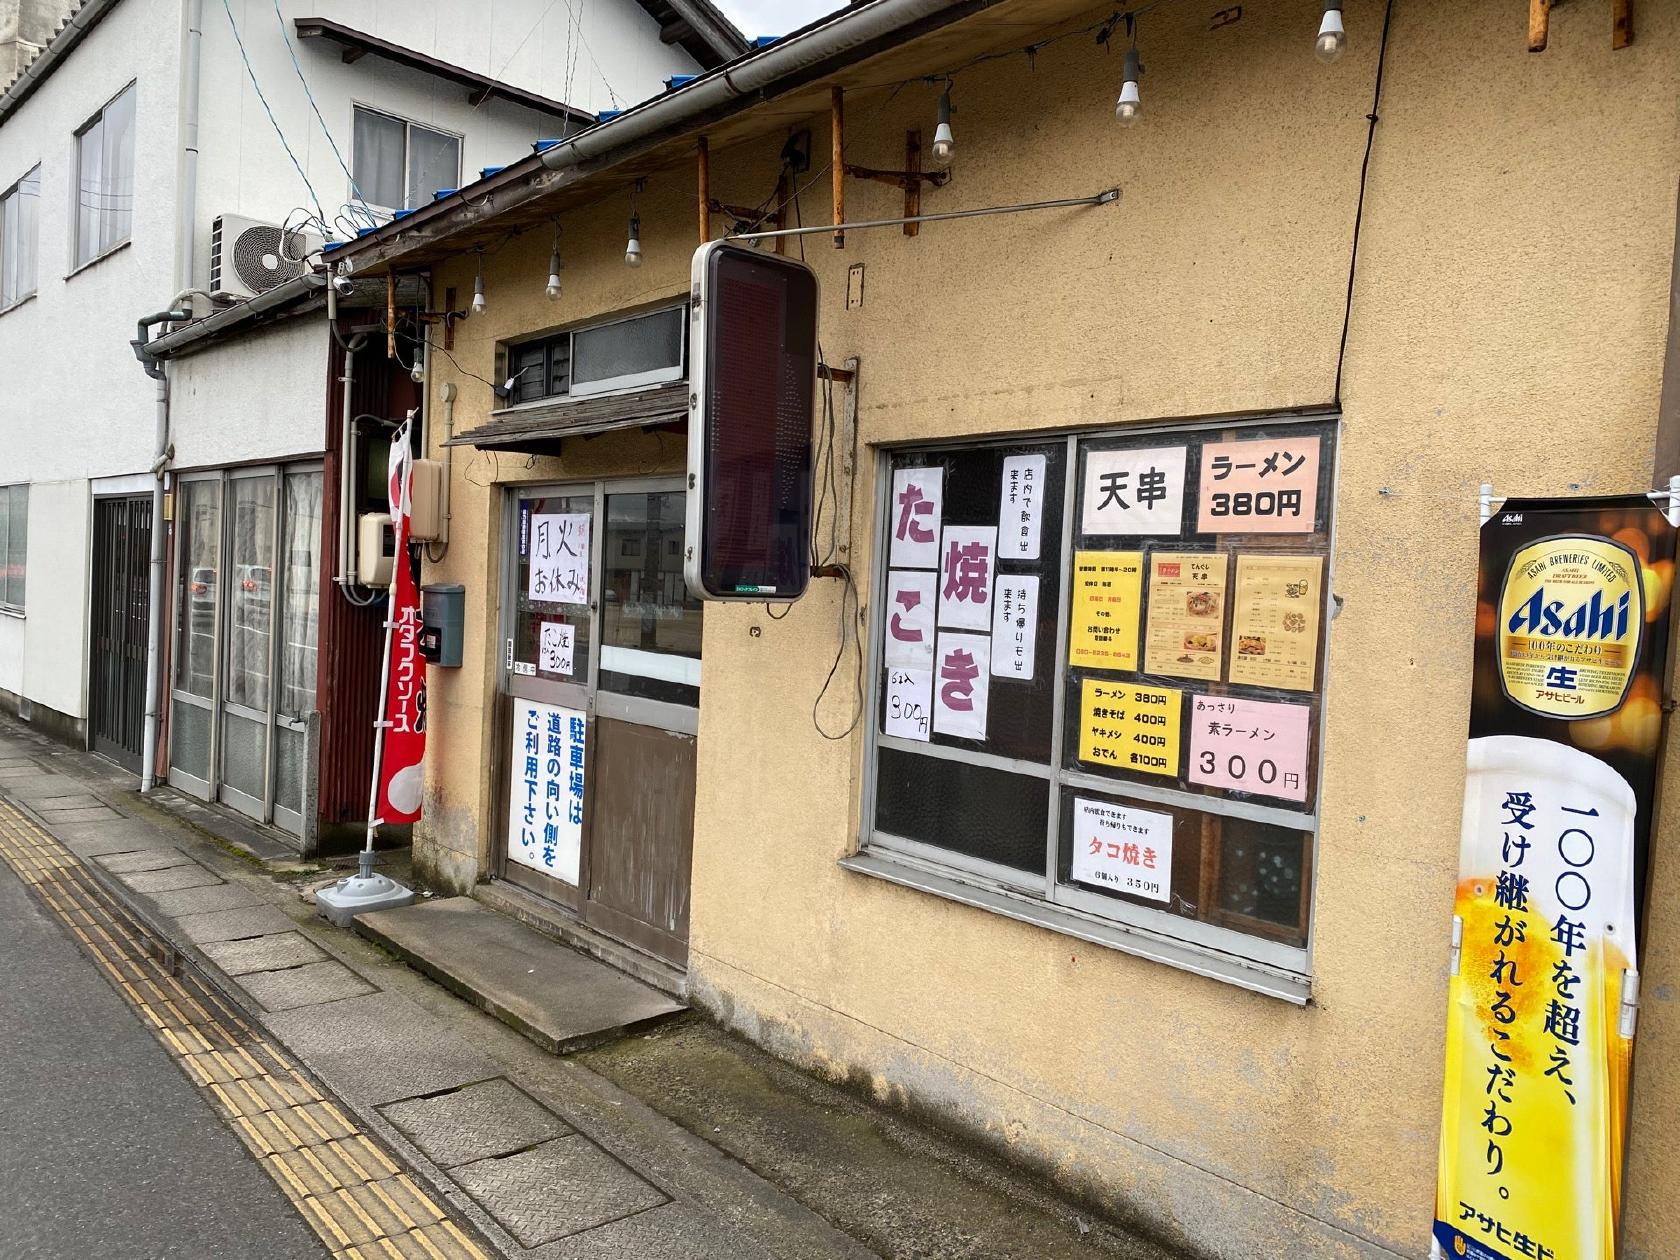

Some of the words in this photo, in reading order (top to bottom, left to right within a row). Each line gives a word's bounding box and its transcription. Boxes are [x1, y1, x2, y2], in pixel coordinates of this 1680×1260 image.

[1211, 451, 1306, 481] ラーメン
[1009, 469, 1018, 504] 来ます
[1097, 466, 1167, 511] 天串
[1210, 489, 1302, 517] 380円
[1502, 513, 1523, 522] Asahi
[536, 519, 578, 560] 月火
[534, 566, 580, 596] お休み
[1192, 572, 1208, 580] 天串
[1527, 561, 1547, 579] ASAHI
[1549, 553, 1590, 566] BREWERIES
[1591, 559, 1617, 583] LIMITED
[1003, 588, 1013, 623] 来ます
[1508, 585, 1632, 641] Asahi
[1087, 626, 1121, 635] お問い合わせ
[1528, 640, 1602, 655] 100年のこだわり
[393, 605, 416, 733] オタフクソース
[1546, 666, 1578, 690] 生
[1094, 688, 1126, 700] ラーメン
[1134, 692, 1167, 705] 380円
[1196, 701, 1236, 714] あっさり
[1535, 690, 1585, 704] アサヒビール
[890, 695, 928, 733] 300円
[1092, 707, 1125, 720] 焼きそば
[1134, 713, 1166, 726] 400円
[1091, 727, 1122, 739] ヤキメシ
[1133, 733, 1166, 747] 400円
[1207, 722, 1276, 741] 素ラーメン
[569, 717, 585, 825] 駐車場は
[1092, 747, 1118, 760] おでん
[1129, 752, 1167, 768] 各100円
[1199, 751, 1299, 790] 300円
[521, 709, 540, 860] ご利用下さい。
[543, 711, 562, 868] 道路の向い側を
[1088, 835, 1157, 870] タコ焼き
[1094, 870, 1119, 884] 6個入り
[1127, 877, 1160, 894] 350円
[1481, 791, 1537, 1201] 受け継がれるこだわり。
